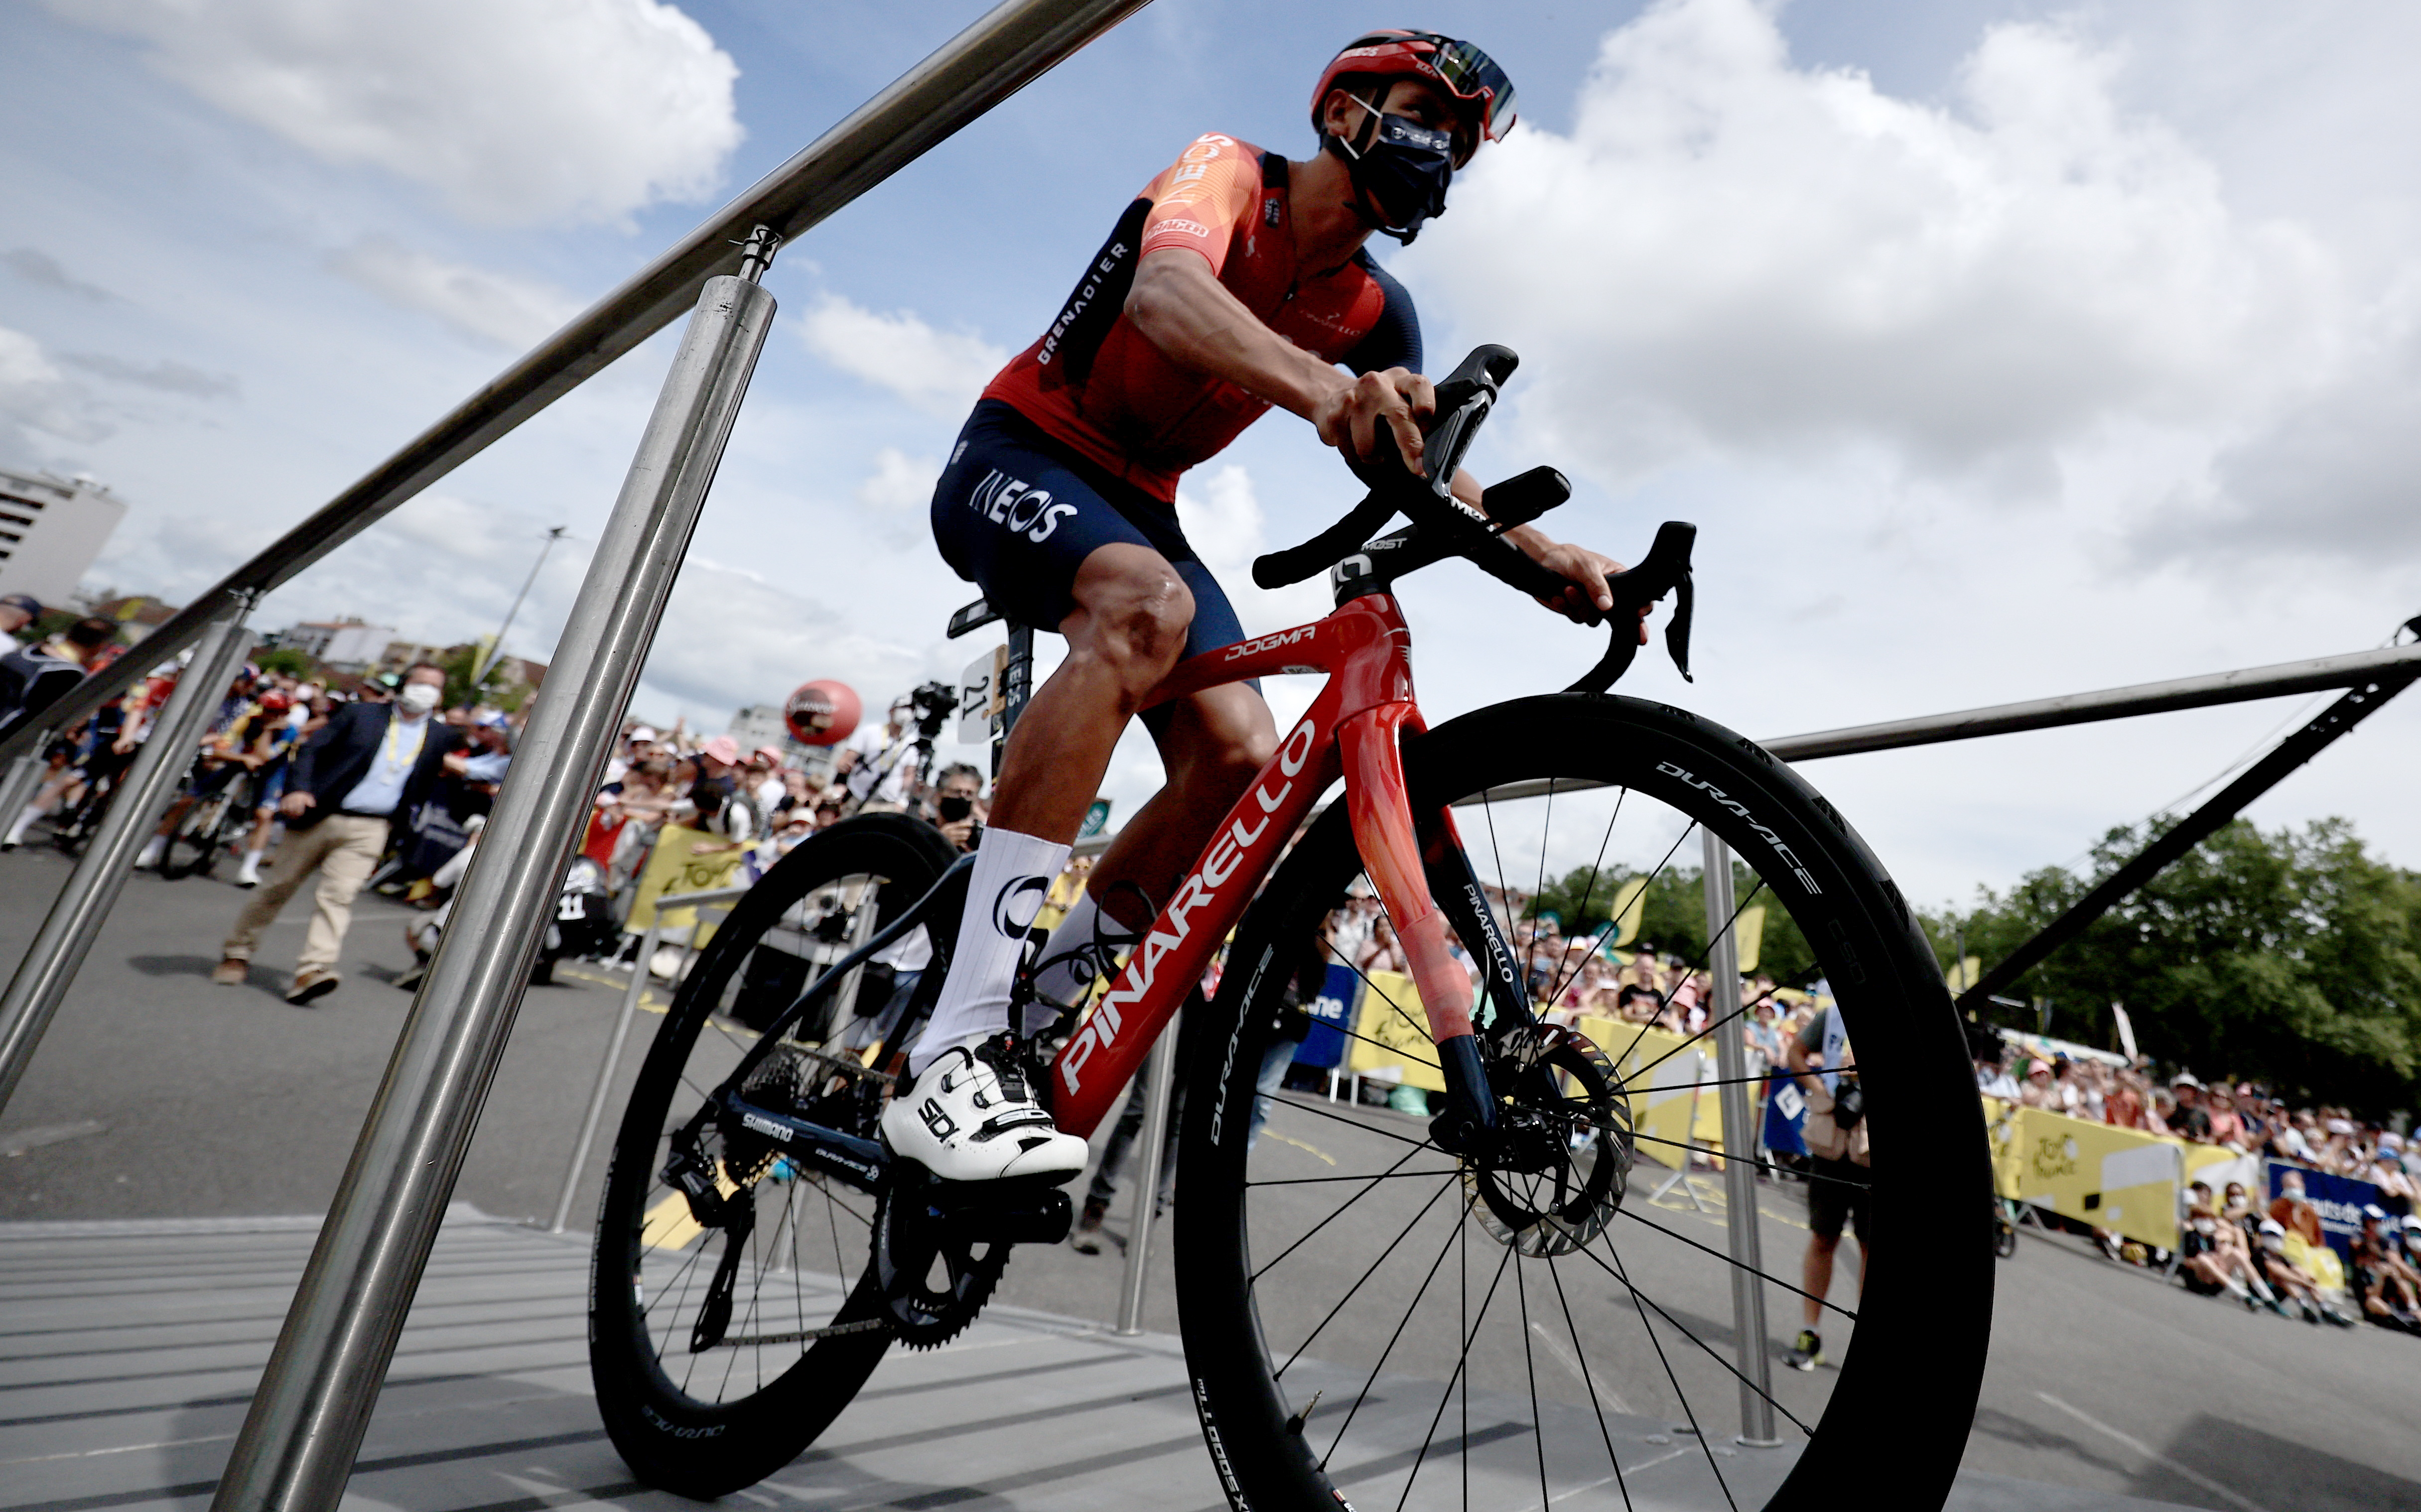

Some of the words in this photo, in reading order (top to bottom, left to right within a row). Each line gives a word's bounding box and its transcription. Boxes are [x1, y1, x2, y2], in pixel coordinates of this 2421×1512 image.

[1037, 242, 1129, 366] GRENADIER
[968, 468, 1078, 543] INEOS
[1224, 625, 1317, 661] DOGMA
[961, 676, 989, 721] 21
[1655, 761, 1823, 895] DURA-ACE
[1210, 943, 1274, 1146] DURA-ACE
[741, 1112, 794, 1142] SHIMANO
[1207, 1425, 1240, 1493] 5000
